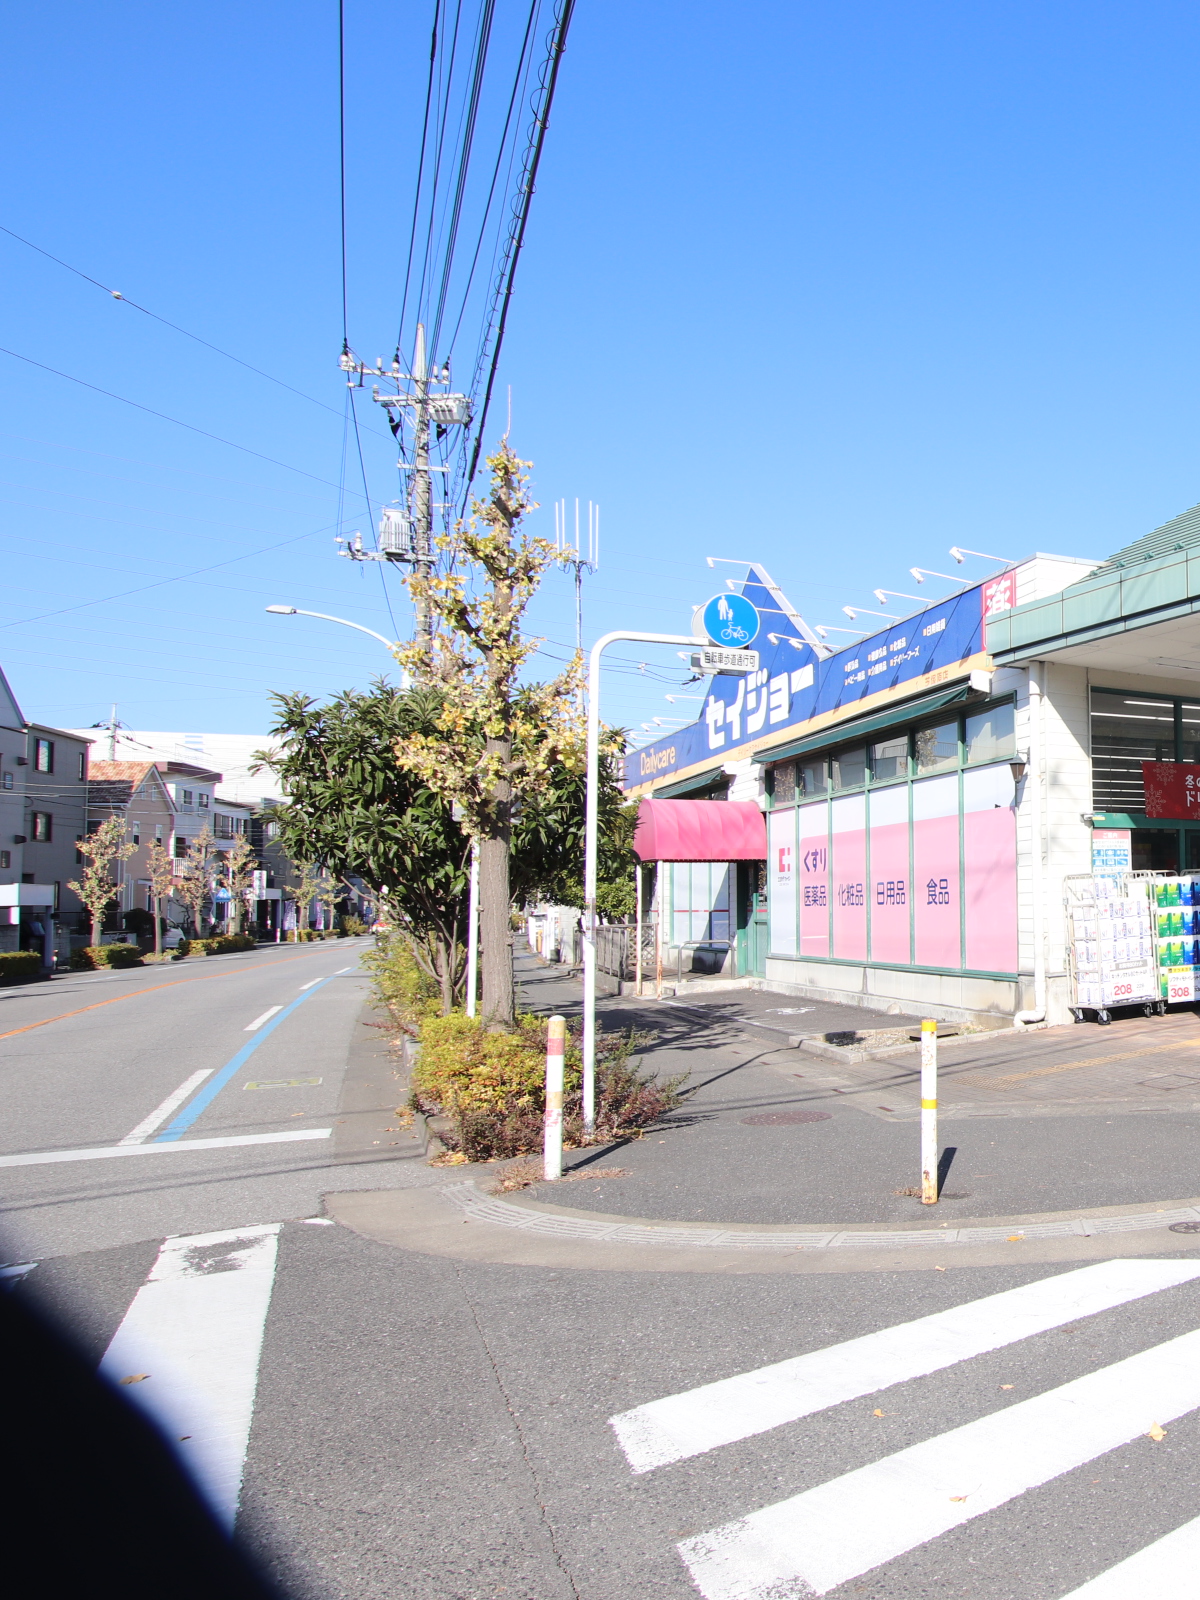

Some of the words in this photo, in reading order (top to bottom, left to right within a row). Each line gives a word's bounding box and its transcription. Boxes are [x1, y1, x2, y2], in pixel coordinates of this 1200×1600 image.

[704, 651, 756, 667] 自転車歩道通行可
[706, 663, 814, 750] セイジョー
[640, 746, 676, 776] Dailycare
[804, 848, 827, 873] くすり
[804, 885, 827, 907] 医薬品
[838, 883, 864, 907] 化粧品
[876, 880, 906, 906] 日用品
[926, 878, 950, 906] 食品
[1113, 983, 1132, 996] 208
[1170, 986, 1190, 998] 308
